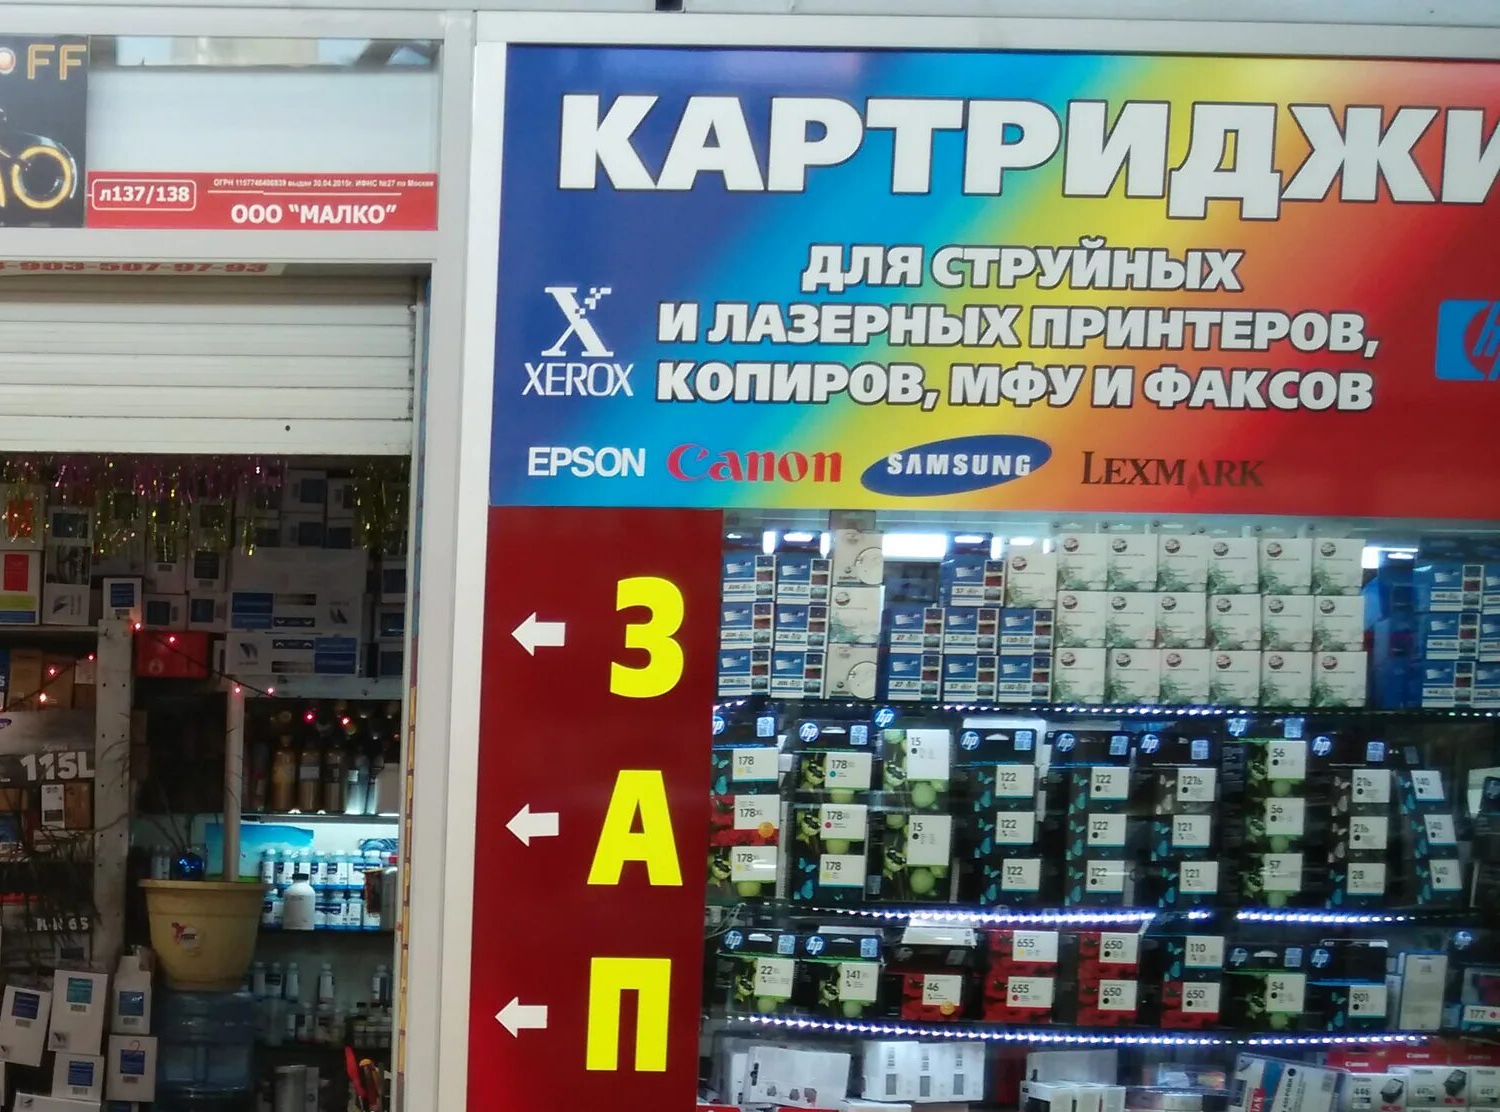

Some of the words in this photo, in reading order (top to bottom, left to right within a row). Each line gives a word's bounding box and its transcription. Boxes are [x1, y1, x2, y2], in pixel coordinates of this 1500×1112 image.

[100, 185, 190, 205] л137/138
[231, 204, 283, 224] ООО
[801, 241, 925, 297] ДЛЯ
[932, 234, 1246, 293] СТРУЙНЫХ
[656, 303, 690, 345] И
[706, 301, 1021, 349] ЛАЗЕРНЫХ
[1028, 305, 1381, 359] ПРИНТЕРОВ,
[521, 361, 634, 397] XEROX
[656, 357, 941, 411] КОПИРОВ,
[947, 361, 1096, 409] МФУ
[1098, 366, 1135, 408] И
[1141, 362, 1376, 413] ФАКСОВ
[528, 446, 647, 479] EPSON
[667, 441, 843, 486] Canon
[886, 449, 1033, 477] SAMSUNG
[1081, 450, 1266, 496] LEXMARK
